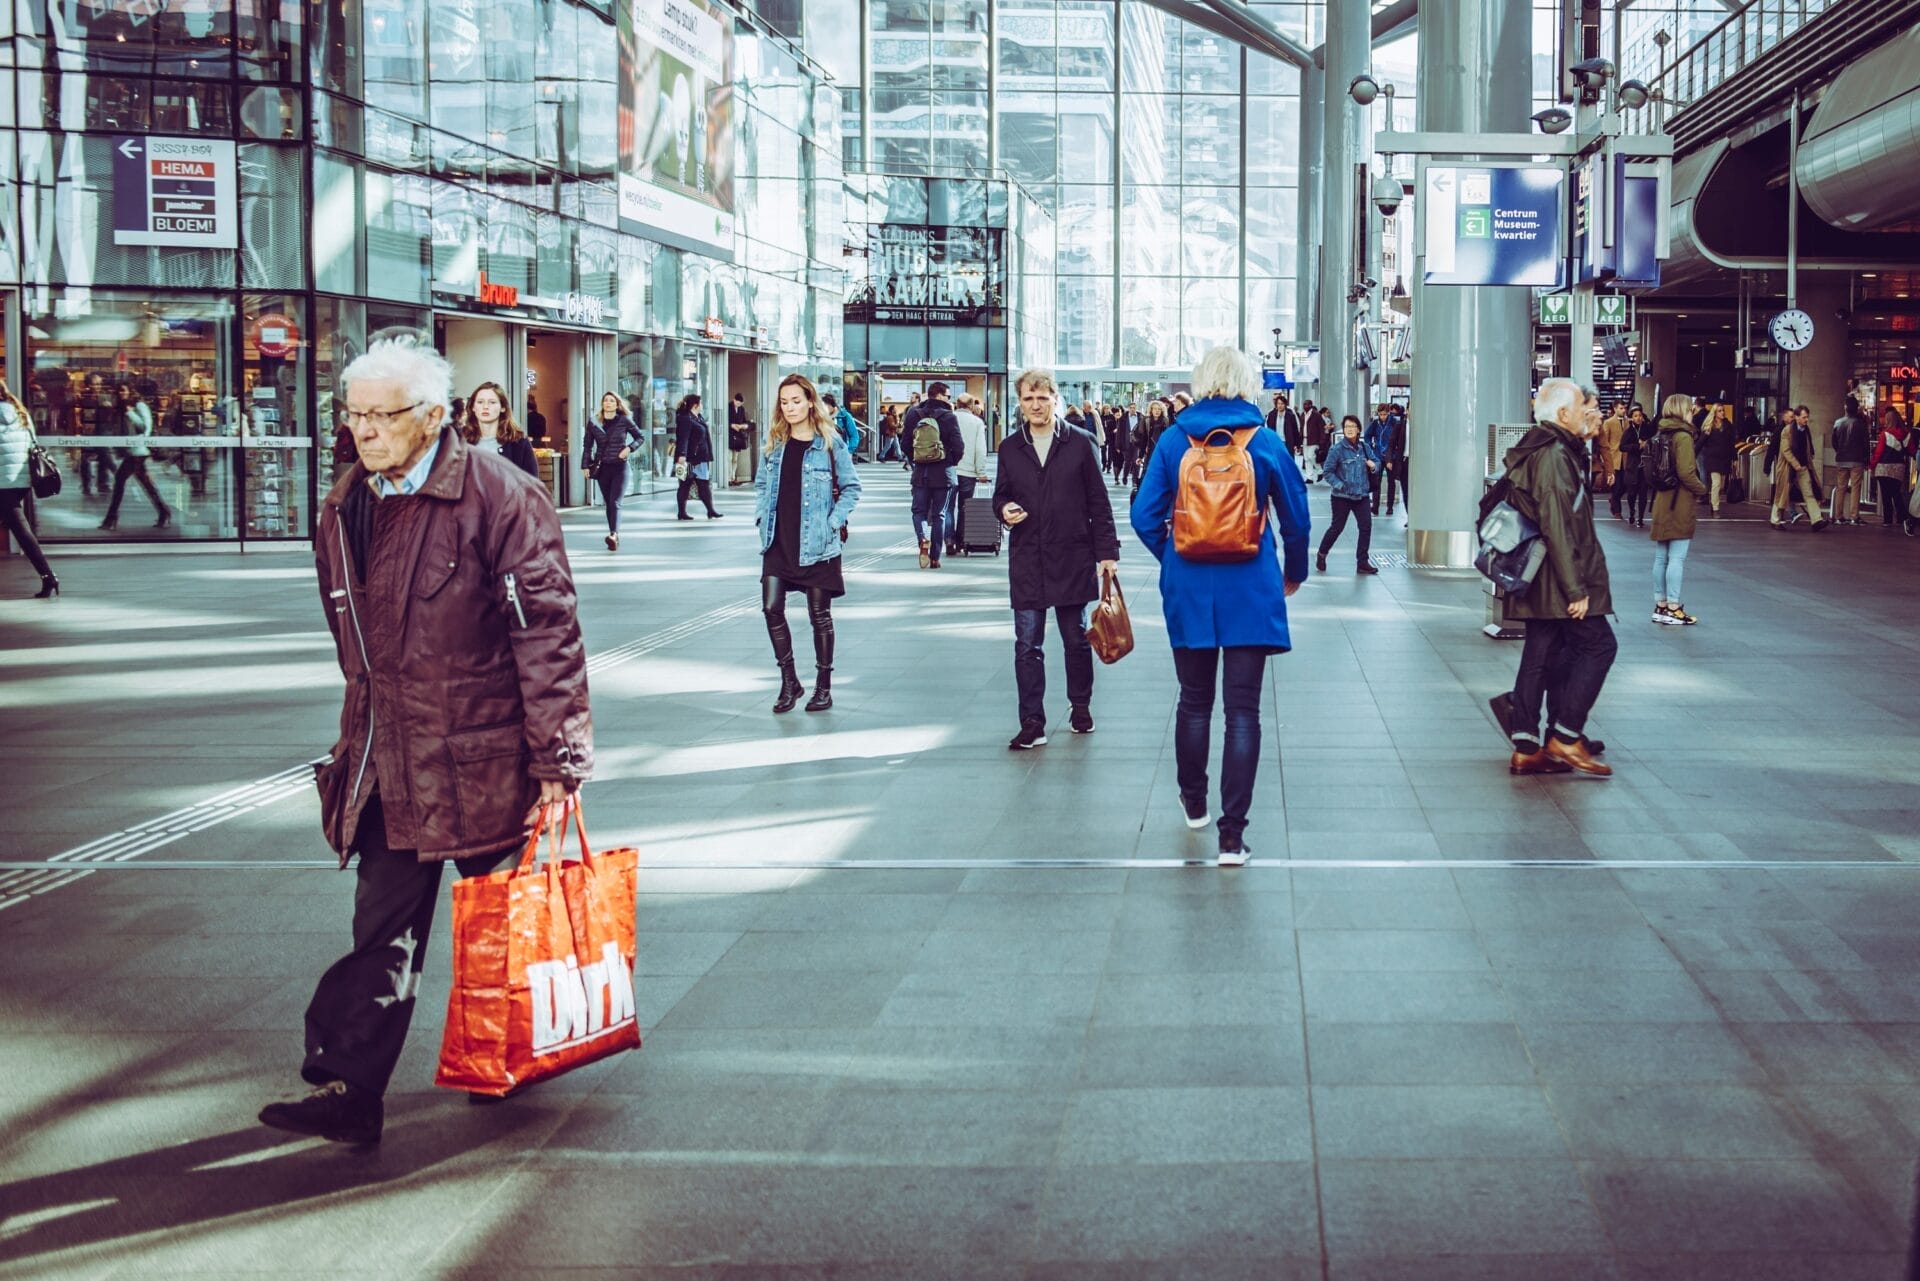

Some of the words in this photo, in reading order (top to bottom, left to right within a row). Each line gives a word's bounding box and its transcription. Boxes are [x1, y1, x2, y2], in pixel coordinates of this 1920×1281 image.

[664, 0, 681, 25] Lamp
[682, 10, 698, 36] stuk?
[160, 162, 205, 176] HEMA
[1494, 208, 1538, 218] Centrum
[156, 218, 213, 232] BLOEM!
[1494, 220, 1540, 229] Museum-
[1494, 231, 1537, 240] kwartier
[480, 271, 518, 307] bruna
[876, 275, 969, 307] KAMER
[892, 311, 904, 320] DEN
[905, 311, 922, 321] HAAG
[924, 311, 956, 321] CENTRAAL
[1543, 314, 1567, 323] AED
[1599, 314, 1622, 323] AED
[58, 438, 90, 446] bruna
[125, 438, 158, 446] brna
[192, 438, 223, 446] bruna
[257, 438, 287, 447] bruna
[526, 940, 636, 1050] Dirk
